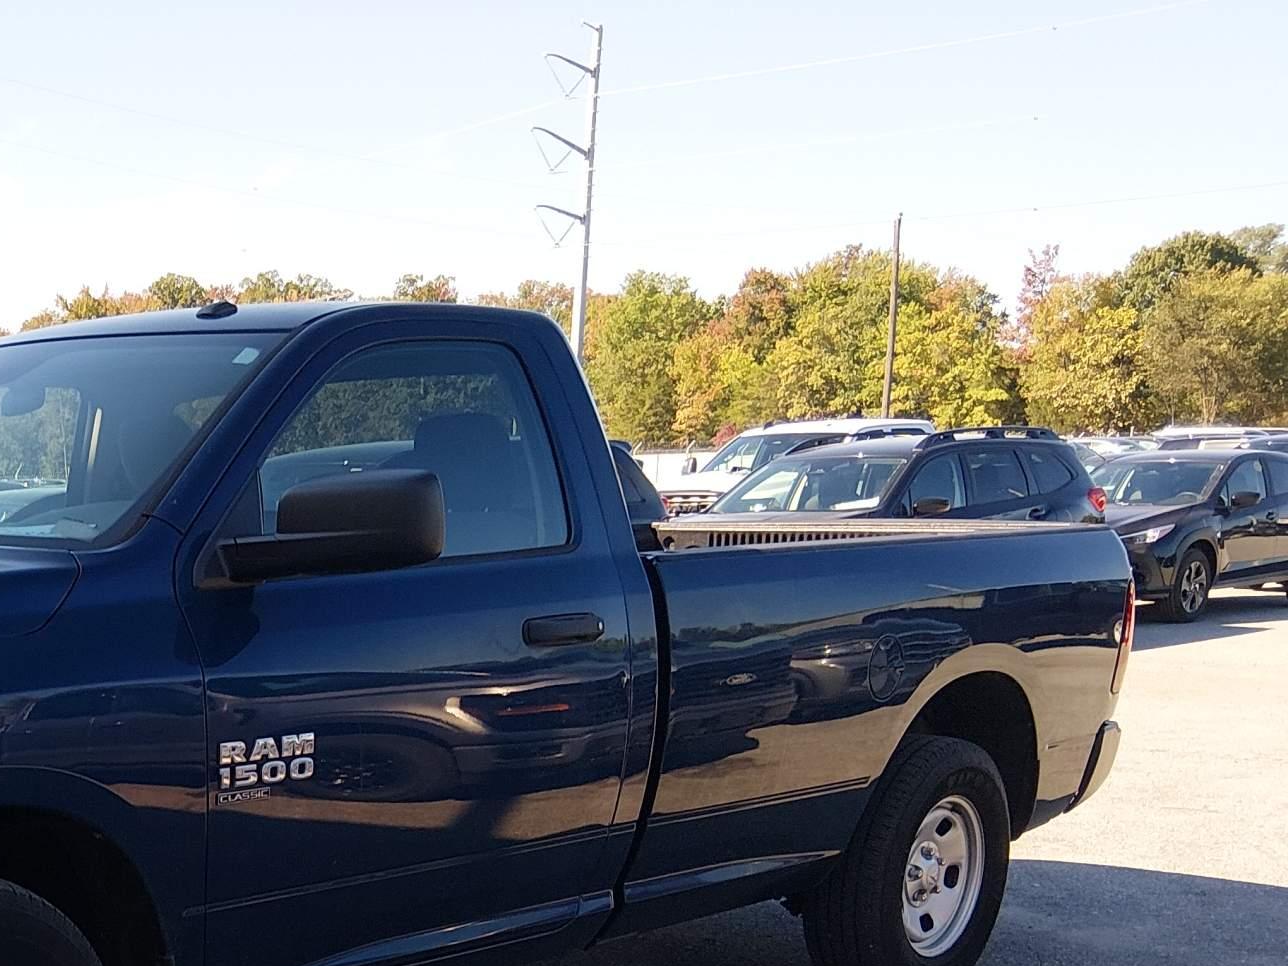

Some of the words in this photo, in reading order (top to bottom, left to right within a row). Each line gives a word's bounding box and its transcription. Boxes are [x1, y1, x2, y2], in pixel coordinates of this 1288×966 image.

[219, 732, 315, 765] RAM
[219, 757, 314, 789] 1500
[220, 789, 268, 803] CLASSIC
